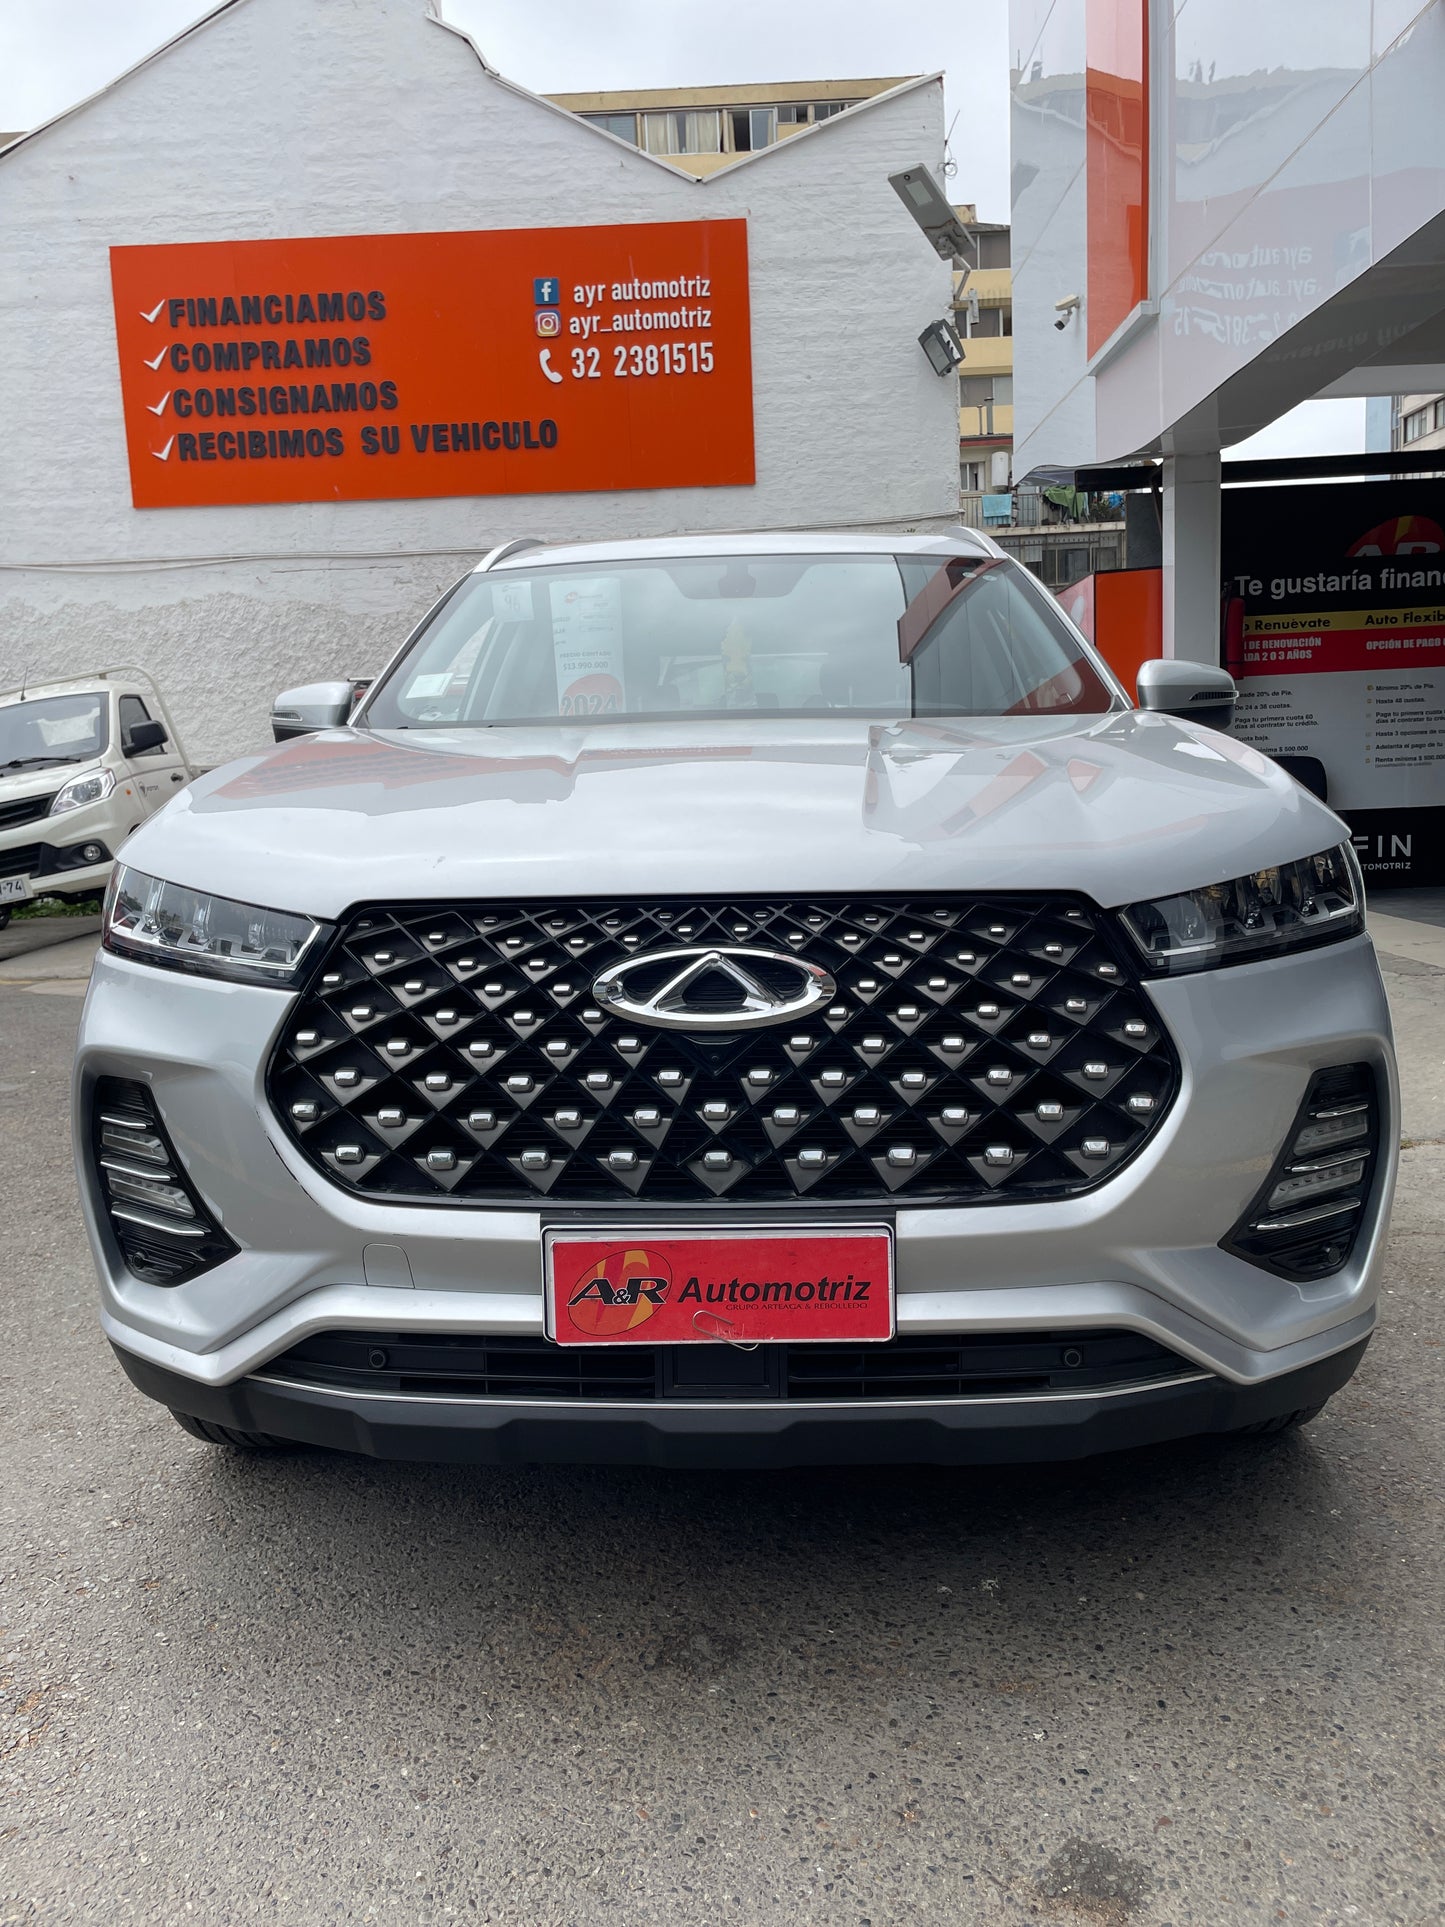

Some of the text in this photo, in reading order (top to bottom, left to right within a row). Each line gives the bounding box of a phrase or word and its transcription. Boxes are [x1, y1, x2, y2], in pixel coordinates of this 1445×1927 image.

[573, 283, 606, 308] ayr
[611, 275, 711, 301] automotriz
[169, 291, 387, 327] FINANCIAMOS
[569, 306, 712, 340] ayr_automotriz
[170, 336, 372, 372] COMPRAMOS
[571, 342, 714, 378] 32 2381515
[173, 381, 398, 418] CONSIGNAMOS
[178, 419, 558, 461] RECIBIMOS SU VEHICULO
[1234, 568, 1445, 599] Te gustaría finan
[1254, 618, 1331, 631] Renuévate
[1365, 615, 1398, 625] Auto
[1248, 640, 1260, 649] DE
[1262, 636, 1322, 649] RENOVACIÓN
[1262, 652, 1268, 661] 2
[1278, 651, 1285, 660] 3
[1286, 649, 1312, 660] AÑOS
[1366, 638, 1402, 650] OPCIÓN
[1403, 639, 1415, 648] DE
[1416, 637, 1441, 648] PAGO
[561, 694, 617, 716] 2024
[1260, 715, 1284, 723] primera
[1360, 861, 1411, 871] TOMOTRIZ
[566, 1275, 871, 1306] A&R Automotriz
[814, 1302, 868, 1310] REBOLLEDO
